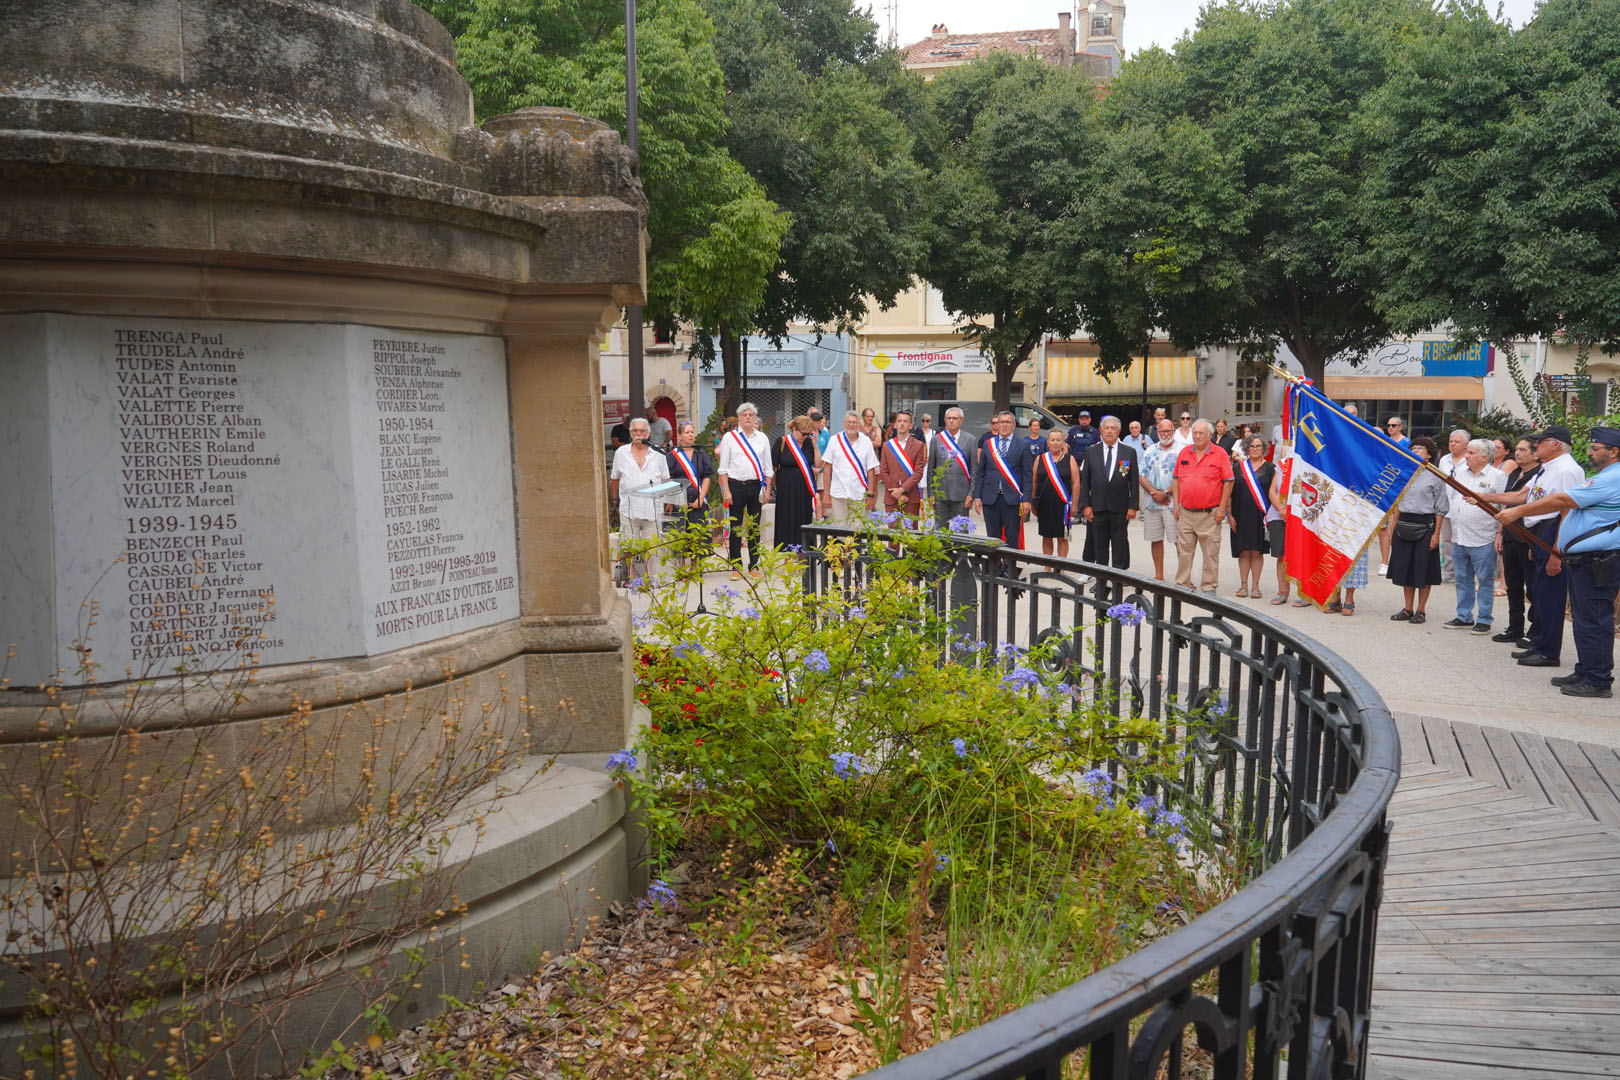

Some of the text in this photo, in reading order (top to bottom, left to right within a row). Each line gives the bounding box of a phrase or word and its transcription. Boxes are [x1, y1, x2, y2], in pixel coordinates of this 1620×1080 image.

[115, 330, 223, 345] TRENGA Paul
[116, 344, 244, 359] TRUDELA André
[373, 340, 445, 354] PEYRIERE Justin
[374, 352, 436, 366] RIPPOL Joseph
[754, 356, 795, 368] apogée
[898, 352, 952, 362] Frontignan
[116, 358, 236, 372] TUDES Antonin
[374, 364, 461, 378] SOUBRIER Alexandre
[118, 372, 238, 385] VALAT Evariste
[375, 377, 444, 389] VENZA Alphonse
[756, 378, 777, 387] yoga
[118, 386, 235, 401] VALAT Georges
[376, 389, 439, 400] CORDIER Léon
[119, 400, 244, 412] VALETTE Pierre
[377, 402, 445, 412] VIVARES Marcel
[120, 414, 262, 426] VALIBOUSE Alban
[379, 418, 433, 431] 1950-1954
[121, 428, 266, 440] VAUTHERIN Emile
[380, 433, 441, 445] BLANC Eugène
[1298, 410, 1326, 454] F
[121, 441, 255, 453] VERGNES Roland
[380, 446, 432, 457] JEAN Lucien
[122, 454, 280, 467] VERGNES Dieudonné
[381, 456, 440, 469] LE GALL René
[123, 468, 247, 481] VERNHET Louis
[382, 468, 448, 481] LISARDE Michel
[123, 482, 233, 495] VIGUIER Jean
[382, 480, 439, 494] LUCAS Julien
[1360, 463, 1402, 513] PEYRADE
[124, 495, 234, 509] WALTZ Marcel
[384, 492, 453, 506] PASTOR François
[384, 503, 437, 518] PUECH René
[1315, 485, 1365, 547] VILLE DE
[127, 514, 237, 533] 1939-1945
[387, 518, 440, 536] 1952-1962
[127, 534, 243, 550] BENZECH Paul
[387, 532, 464, 550] CAYUELAS Francis
[128, 548, 246, 564] BOUDE Charles
[388, 545, 455, 562] PEZZOTTI Pierre
[128, 561, 263, 578] CASSAGNE Victor
[390, 558, 443, 580] 1992-1996
[449, 551, 496, 569] 1995-2019
[449, 568, 480, 582] POINTEAU
[129, 574, 244, 591] CAUBEL André
[390, 576, 436, 593] AZZI Bruno
[129, 585, 274, 605] CHABAUD Fernand
[375, 577, 514, 618] AUX FRANCAIS D'OUTRE-MER
[130, 602, 264, 619] CORDIER Jacques
[376, 597, 497, 637] MORTS POUR LA FRANCE
[130, 613, 276, 633] MARTINEZ Jacques
[131, 630, 215, 646] GALIBERT
[132, 642, 221, 660] PATALANO
